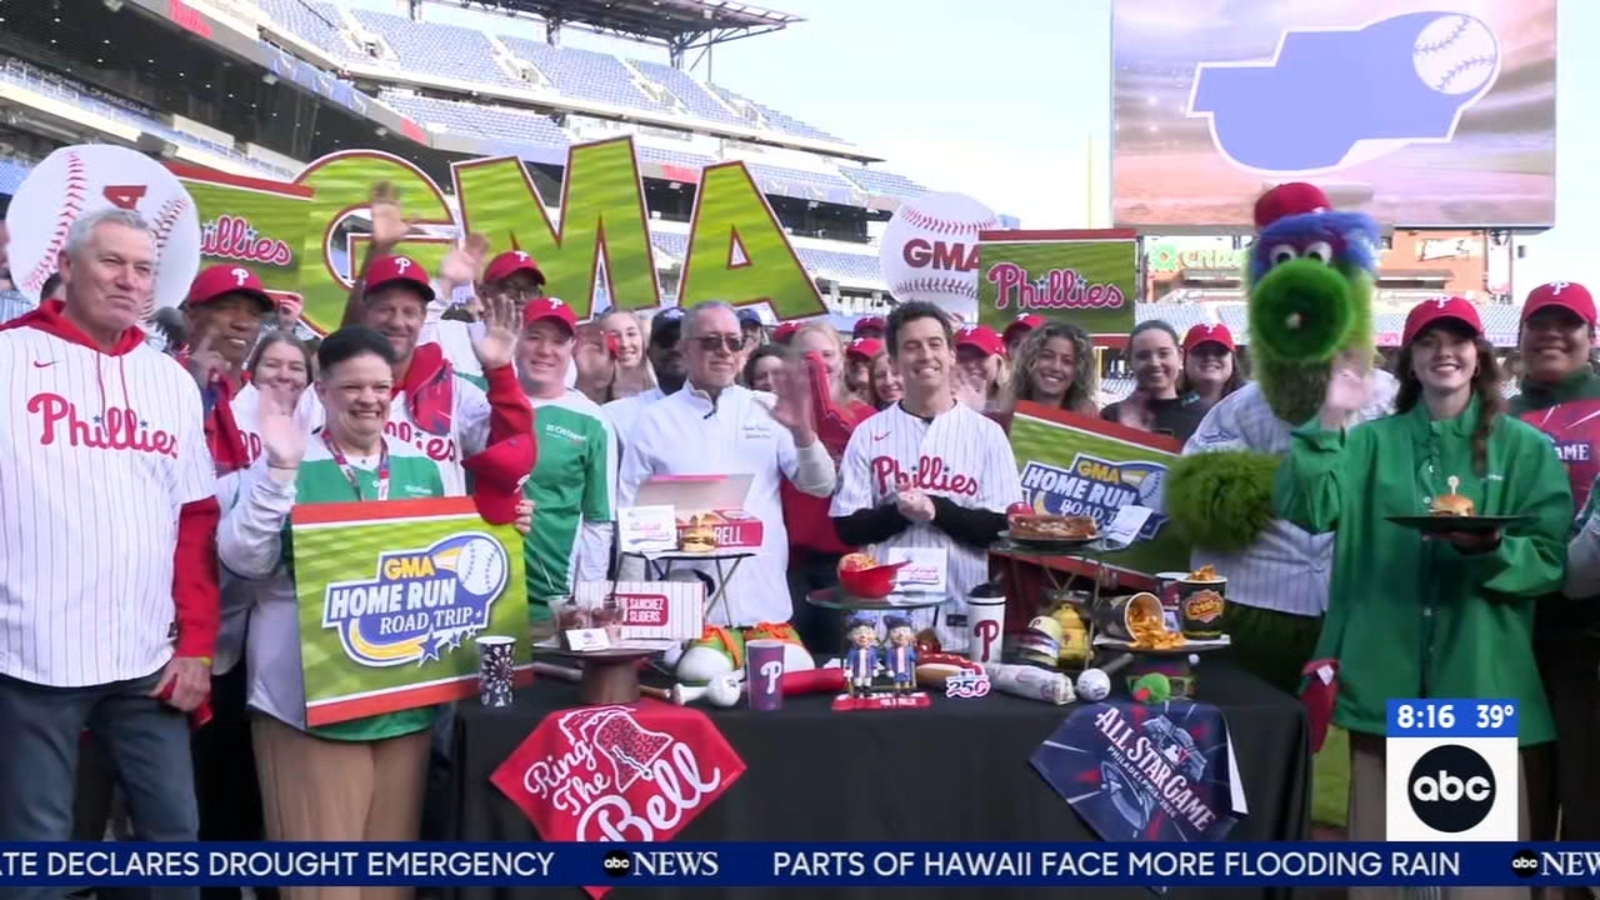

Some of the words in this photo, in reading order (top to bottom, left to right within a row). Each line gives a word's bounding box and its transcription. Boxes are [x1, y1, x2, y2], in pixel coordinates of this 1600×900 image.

[200, 214, 291, 266] illies
[294, 135, 828, 336] GMA
[987, 262, 1123, 309] Phillies
[27, 393, 179, 460] Phillies
[872, 456, 978, 496] Phillies
[1024, 467, 1086, 500] HOME
[1088, 483, 1137, 509] RUN
[1077, 459, 1121, 484] GMA
[384, 555, 436, 580] GMA
[330, 583, 403, 620] HOME
[407, 578, 456, 610] RUN
[379, 612, 429, 636] ROAD
[434, 606, 474, 628] TRIP
[974, 619, 999, 663] P
[760, 660, 782, 695] P
[524, 739, 596, 799] Ring
[1094, 707, 1135, 751] ALL
[1127, 736, 1171, 790] STAR
[1163, 775, 1216, 831] GAME
[553, 773, 610, 816] The
[577, 742, 721, 842] Bell
